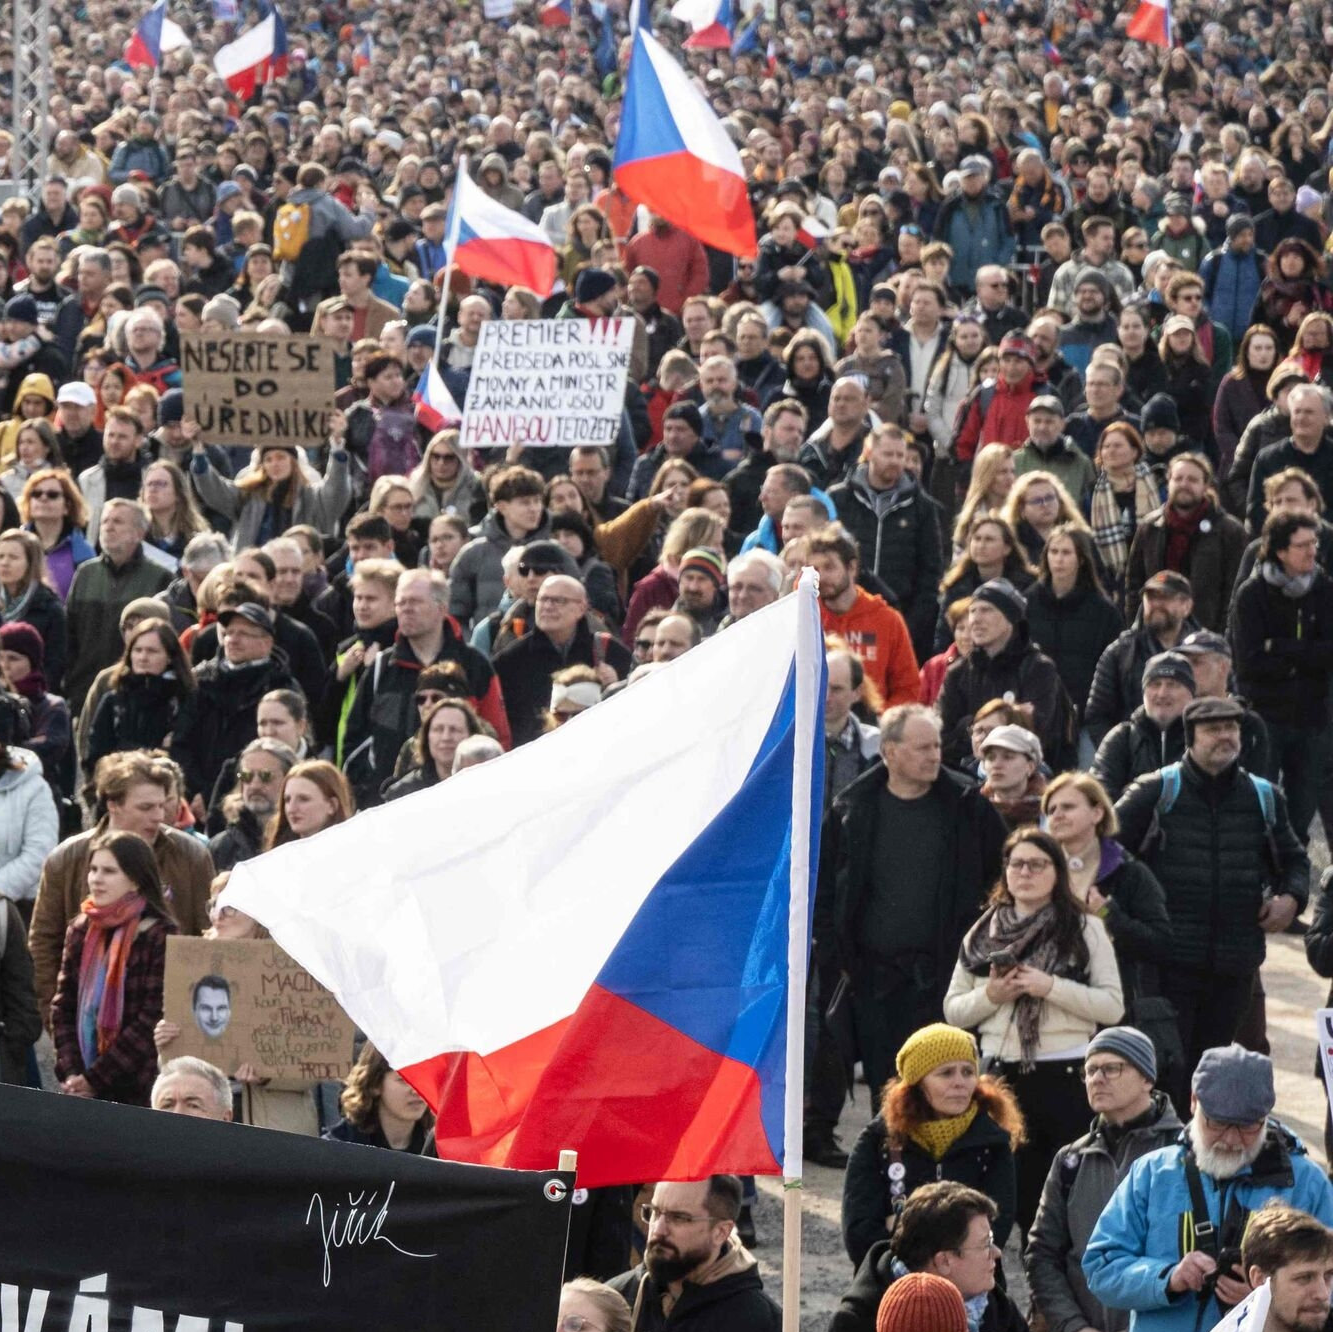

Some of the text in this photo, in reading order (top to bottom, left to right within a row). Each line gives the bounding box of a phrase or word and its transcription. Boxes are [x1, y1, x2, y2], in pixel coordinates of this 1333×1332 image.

[286, 341, 321, 373] SE
[234, 377, 279, 398] DO
[533, 377, 546, 392] A
[549, 373, 618, 393] MINISTR
[566, 394, 605, 410] JSOU
[464, 413, 553, 443] HANBOU
[261, 971, 329, 996] MACIN
